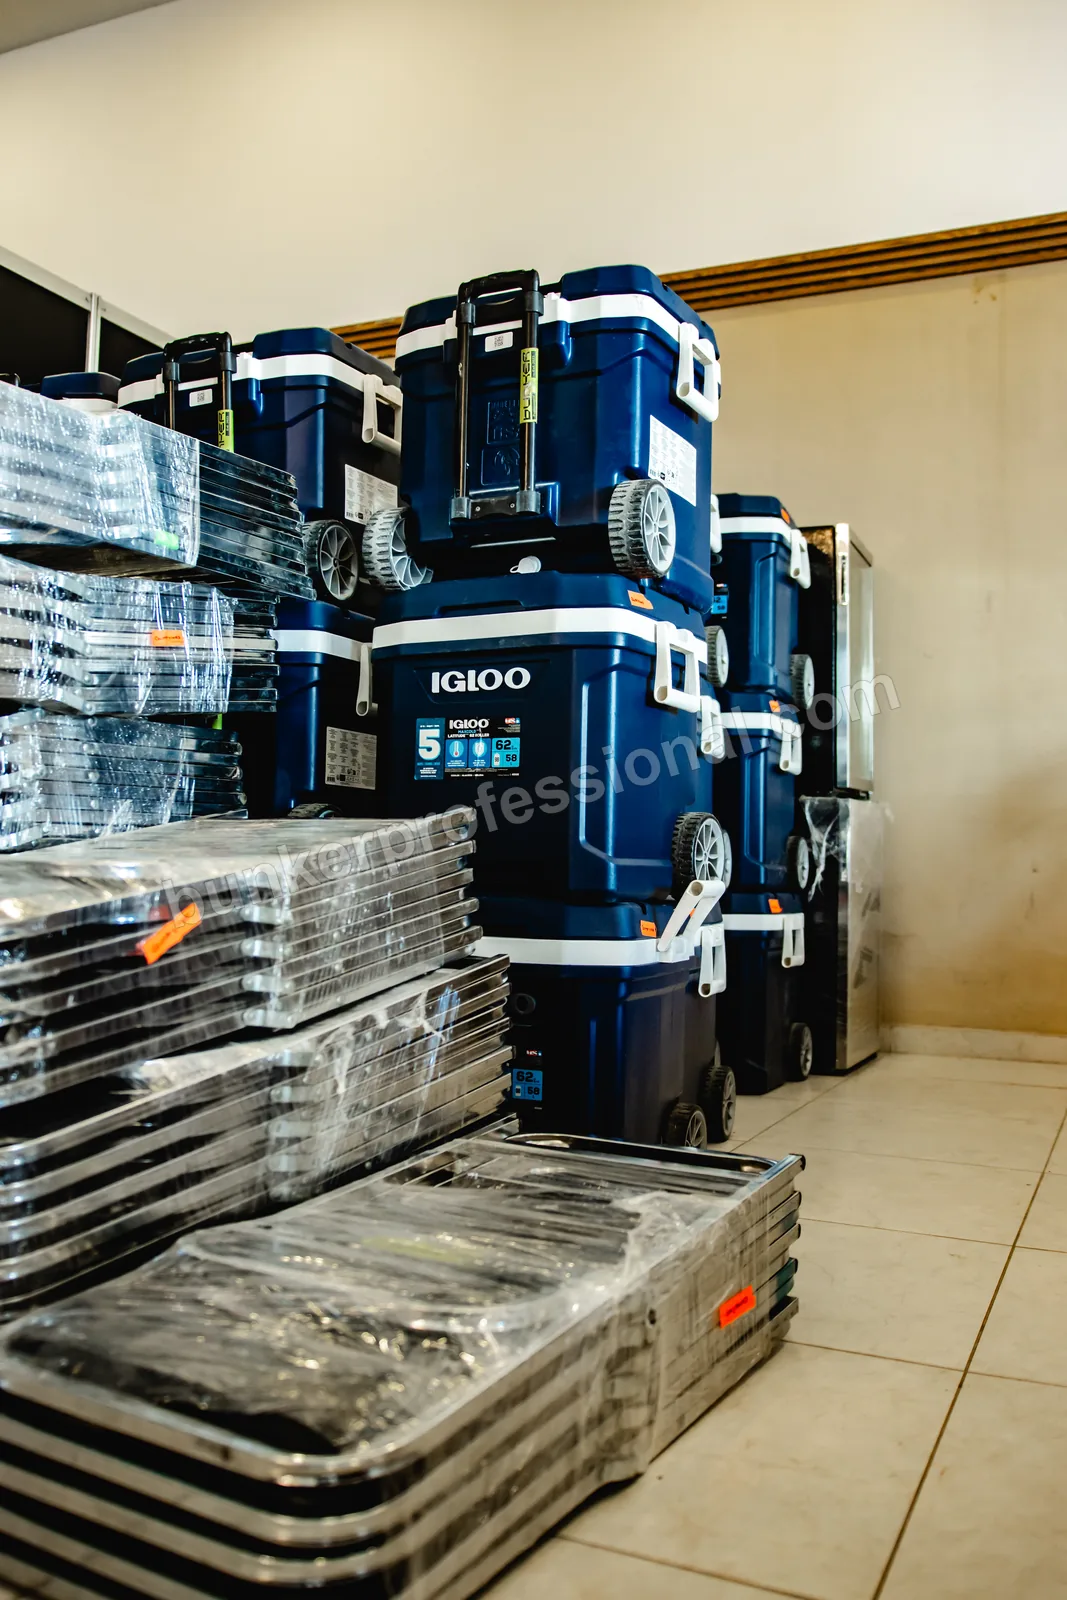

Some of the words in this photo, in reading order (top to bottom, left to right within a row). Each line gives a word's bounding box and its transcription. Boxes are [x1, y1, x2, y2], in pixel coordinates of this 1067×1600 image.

[431, 667, 531, 693] IGLOO
[449, 718, 489, 729] IGLOO
[418, 729, 441, 760] 5
[495, 740, 511, 750] 62
[505, 754, 517, 762] 58
[516, 1071, 533, 1082] 62
